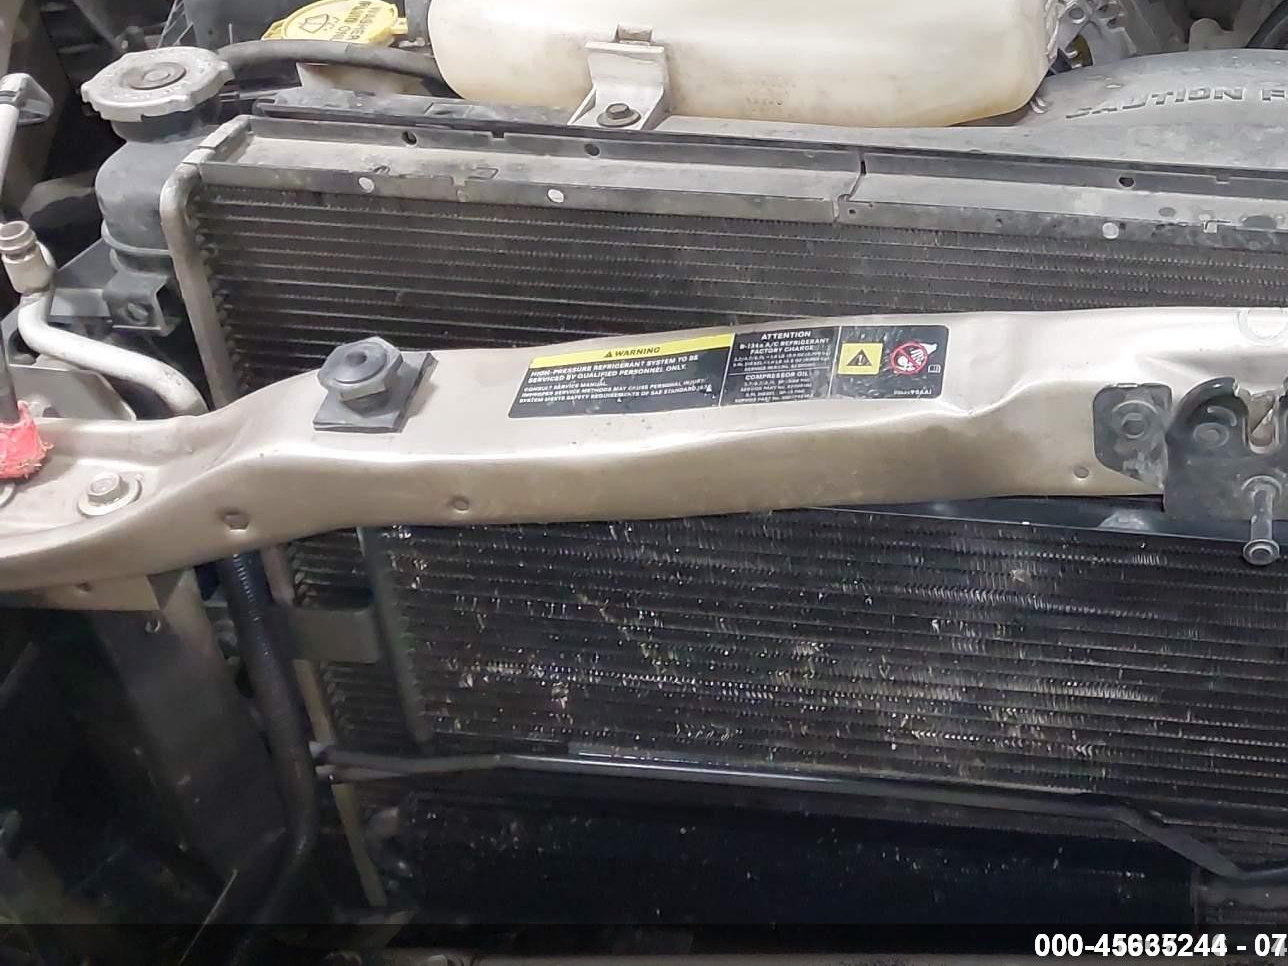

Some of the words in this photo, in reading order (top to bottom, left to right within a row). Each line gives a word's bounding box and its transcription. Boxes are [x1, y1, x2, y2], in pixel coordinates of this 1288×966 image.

[1065, 86, 1244, 119] CAUTION
[761, 330, 812, 340] ATTENTION
[780, 338, 830, 347] REFRIGERANT
[615, 346, 661, 357] WARNING
[750, 347, 783, 355] FACTORY
[530, 365, 592, 377] HIGH-PRESSURE
[593, 360, 645, 371] REFRIGERANT
[646, 357, 676, 366] SYSTEM
[528, 375, 565, 384] SERVICED
[577, 370, 618, 379] QUALIFIED
[619, 367, 664, 376] PERSONNEL
[665, 364, 687, 372] ONLY.
[745, 371, 796, 381] COMPRESSOR
[663, 386, 697, 394] STANDARD
